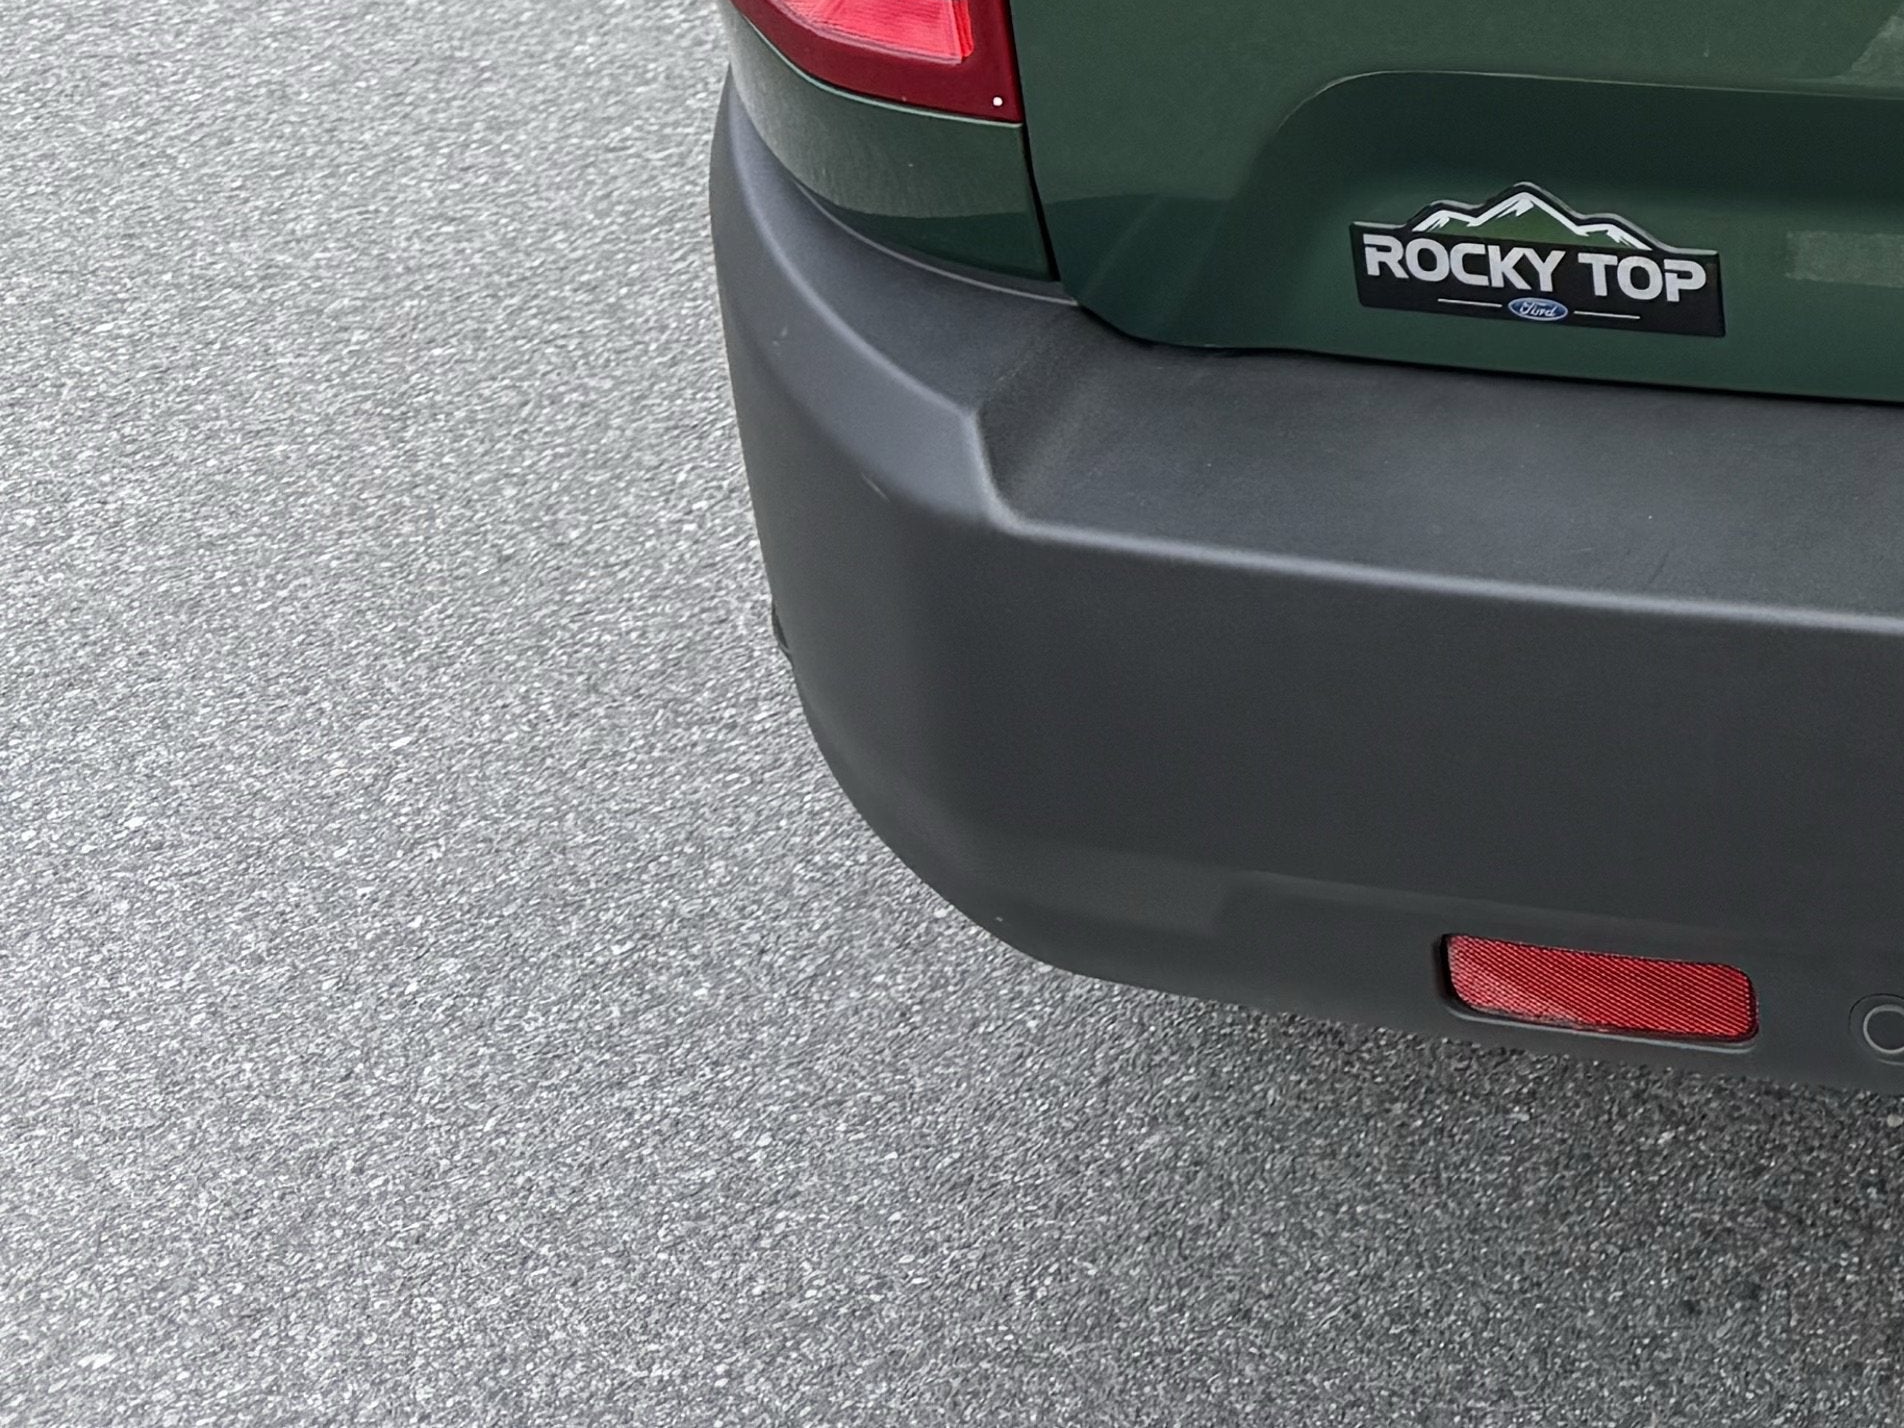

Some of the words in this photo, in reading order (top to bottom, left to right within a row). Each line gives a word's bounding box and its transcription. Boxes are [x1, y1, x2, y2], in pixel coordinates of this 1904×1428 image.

[1363, 234, 1565, 293] ROCKY
[1578, 253, 1706, 302] TOP
[1519, 301, 1560, 319] Ford
